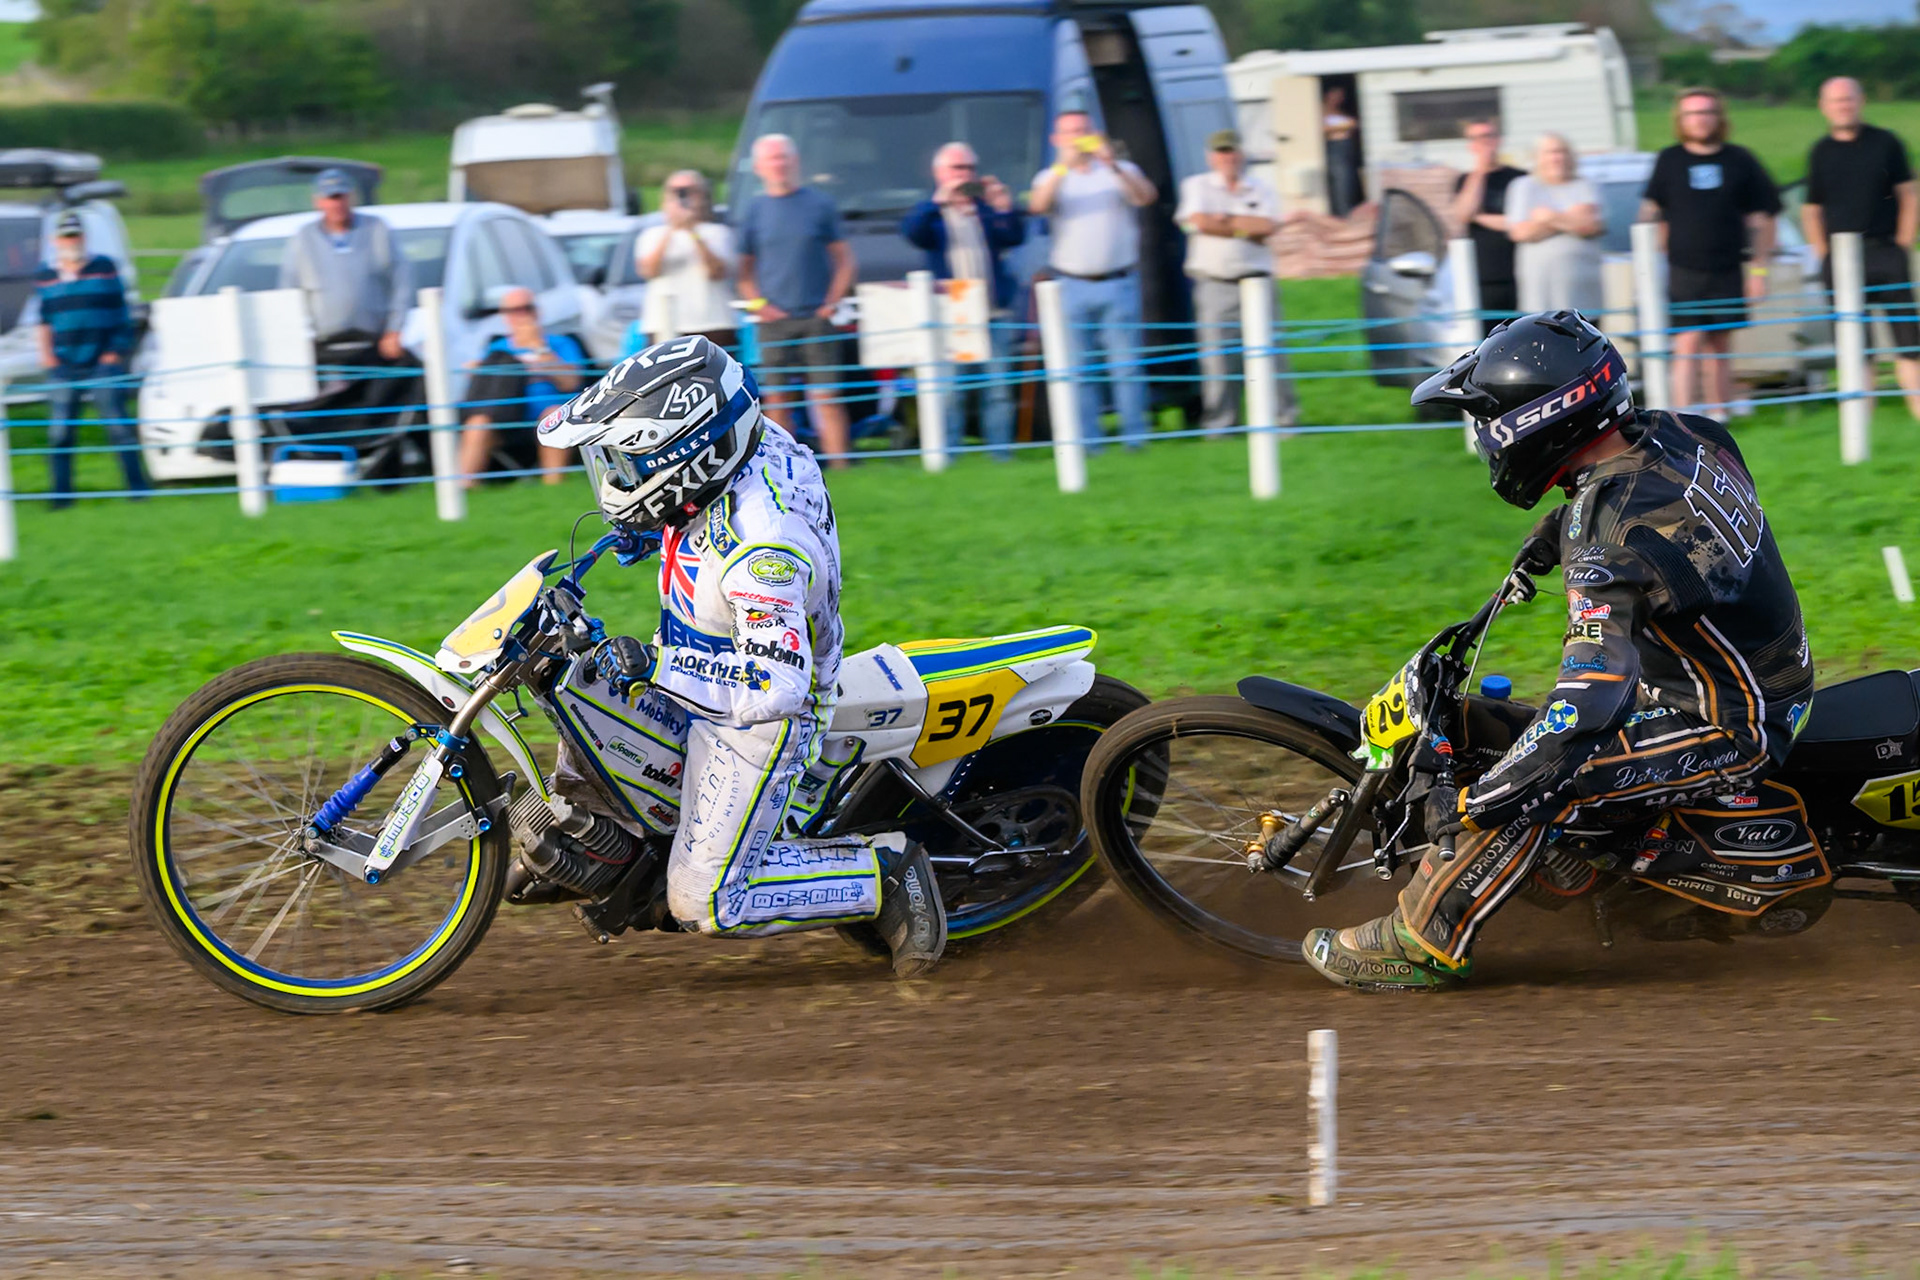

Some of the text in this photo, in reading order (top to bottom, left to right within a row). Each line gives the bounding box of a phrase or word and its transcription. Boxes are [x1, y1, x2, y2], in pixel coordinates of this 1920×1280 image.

[1515, 362, 1613, 432] SCOTT
[645, 430, 712, 469] OAKLEY
[643, 443, 726, 520] FXR
[1567, 568, 1600, 580] Vale
[744, 637, 806, 672] tobin
[670, 665, 713, 684] DEMOLITION
[723, 680, 737, 689] LTD
[636, 698, 686, 737] Mobility
[869, 707, 903, 728] 37
[928, 693, 995, 743] 37
[1524, 743, 1537, 755] LTD
[641, 763, 678, 788] tobin
[380, 773, 431, 854] BOMBER
[708, 770, 740, 839] GLULAM LTD
[1737, 824, 1781, 841] Vale
[1455, 813, 1531, 891] VM PRODUCTS
[752, 885, 859, 909] BOMBER
[1666, 878, 1762, 905] CHRIS Terry
[1327, 950, 1413, 977] daytona
